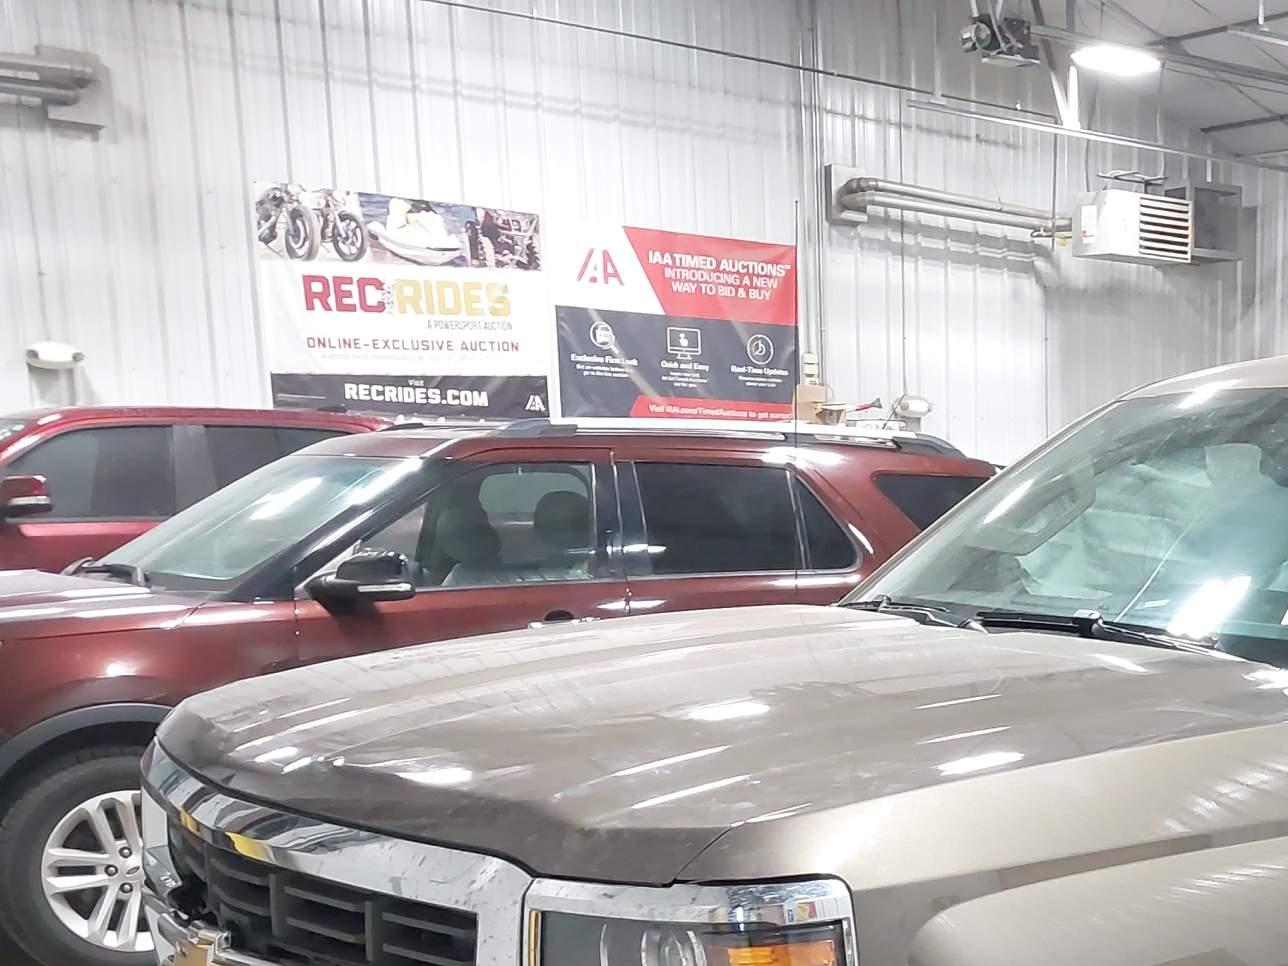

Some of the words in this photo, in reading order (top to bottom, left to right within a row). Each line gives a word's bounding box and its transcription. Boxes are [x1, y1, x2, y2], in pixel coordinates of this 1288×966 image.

[649, 250, 672, 266] IAA
[673, 253, 717, 270] TIMED
[664, 267, 740, 285] INTRODUCING
[742, 275, 751, 286] A
[753, 276, 778, 289] NEW
[302, 274, 386, 313] REC
[394, 278, 513, 317] RIDES
[672, 281, 696, 294] WAY
[700, 283, 716, 295] TO
[719, 285, 735, 298] BID
[738, 287, 746, 299] &
[749, 288, 772, 301] BUY
[434, 320, 481, 330] POWERSPORT
[483, 321, 513, 331] AUCTION
[306, 336, 454, 352] ONLINE-EXCLUSIVE
[461, 341, 519, 352] AUCTION
[344, 382, 489, 407] RECRIDES.COM
